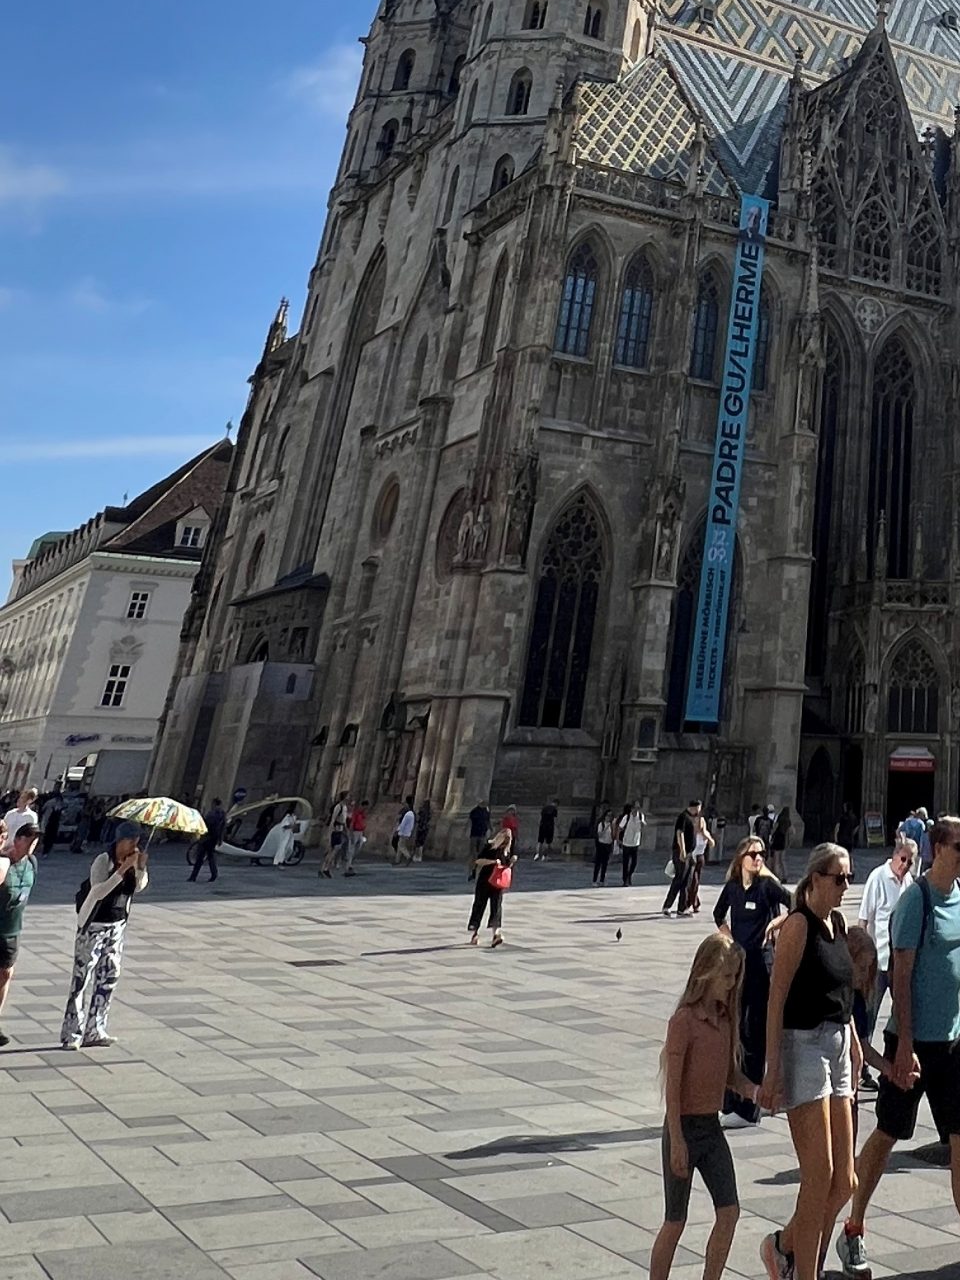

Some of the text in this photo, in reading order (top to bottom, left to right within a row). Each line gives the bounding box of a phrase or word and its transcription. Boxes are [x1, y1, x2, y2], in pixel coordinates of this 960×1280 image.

[712, 421, 741, 525] PADRE
[695, 567, 714, 689] SEEBÜHNE MÖRBISCH
[707, 645, 718, 690] TICKETS
